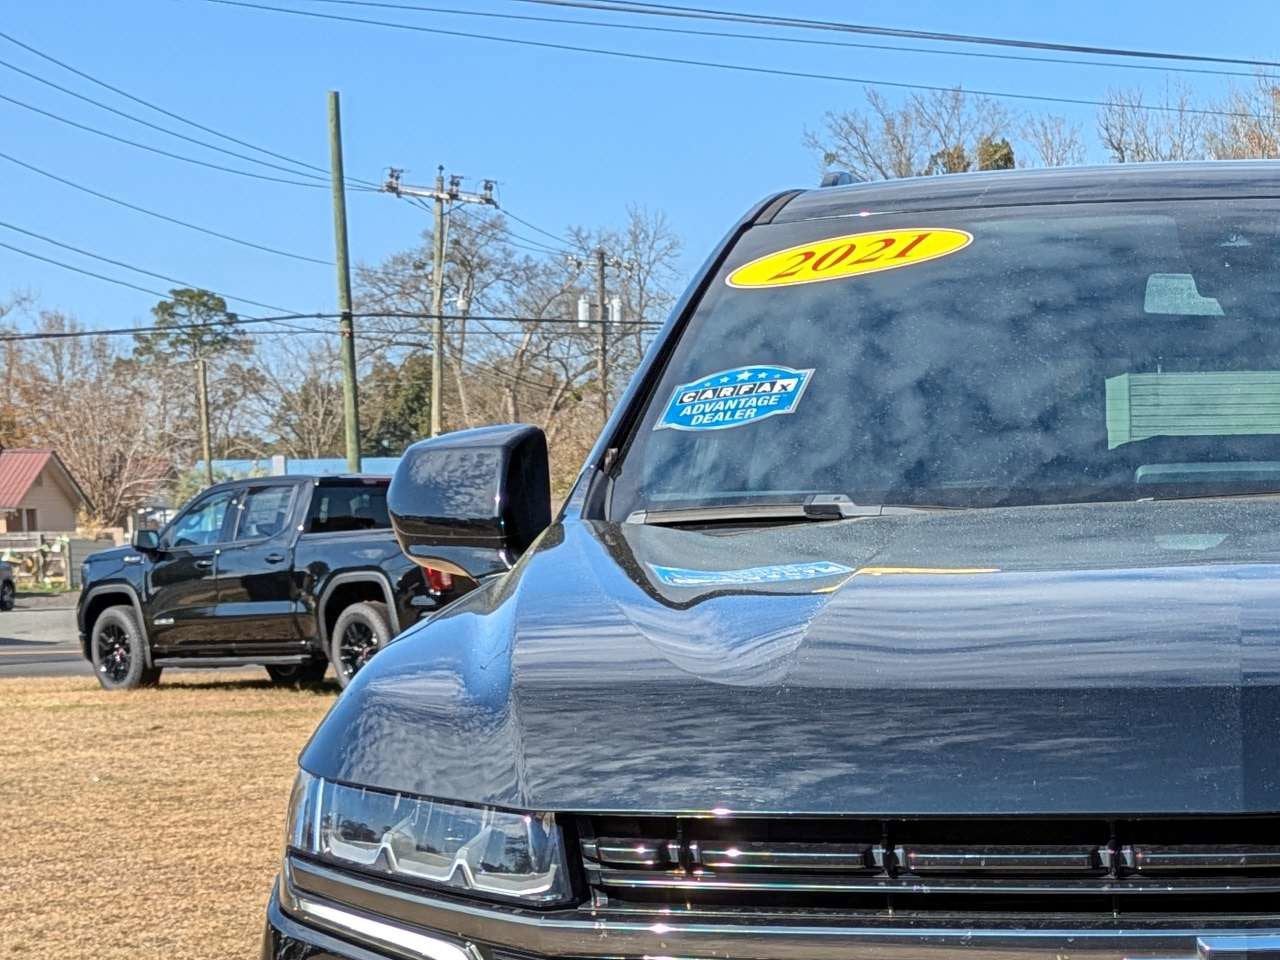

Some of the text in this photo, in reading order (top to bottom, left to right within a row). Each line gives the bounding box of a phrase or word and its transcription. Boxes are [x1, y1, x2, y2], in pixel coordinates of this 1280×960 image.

[768, 233, 930, 280] 2021
[681, 383, 791, 404] CARFAX
[680, 396, 780, 417] ADVANTAGE
[691, 408, 757, 426] DEALER
